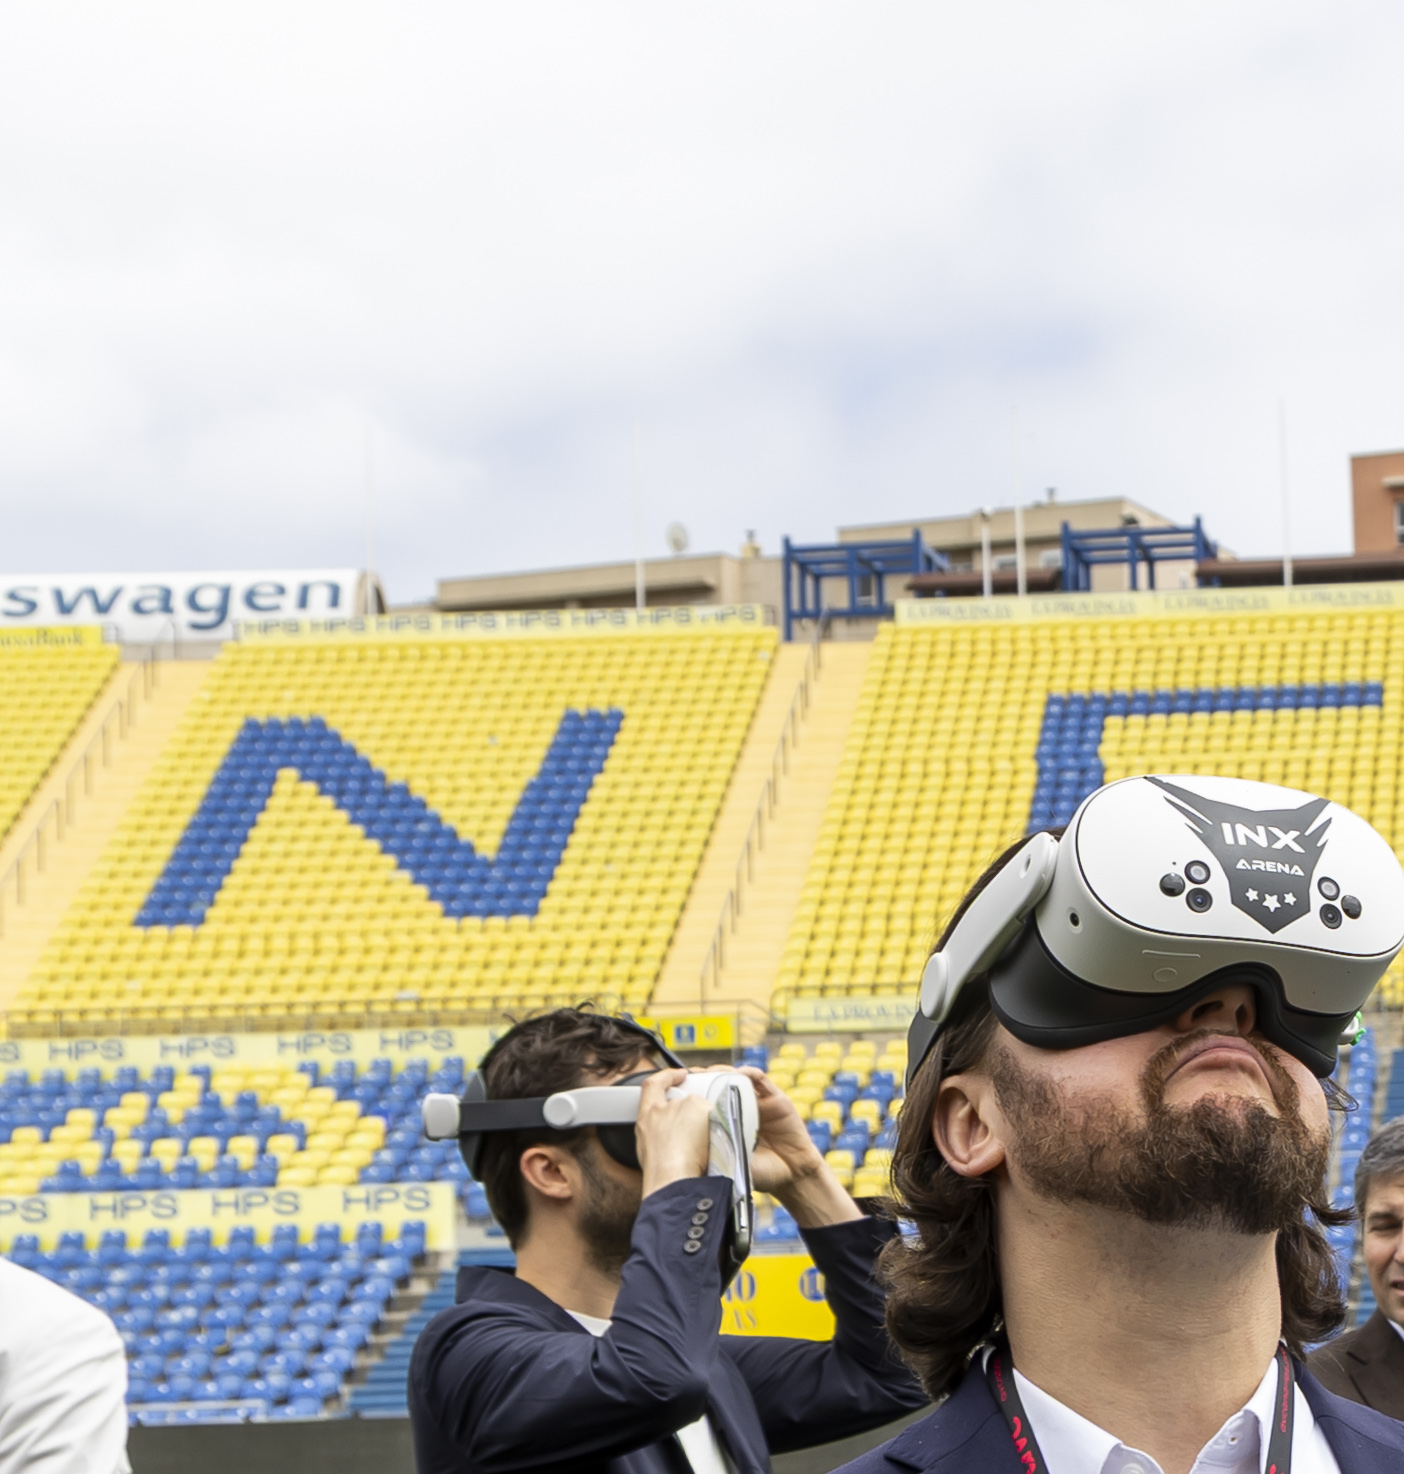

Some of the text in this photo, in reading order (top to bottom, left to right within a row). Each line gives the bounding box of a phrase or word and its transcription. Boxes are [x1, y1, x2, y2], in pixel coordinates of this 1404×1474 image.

[1, 579, 341, 631] swagen
[1221, 822, 1306, 853] INX
[1236, 859, 1305, 876] ARENA
[49, 1039, 125, 1062] HPS
[161, 1036, 237, 1059] HPS
[277, 1032, 353, 1056] HPS
[379, 1029, 455, 1053] HPS
[90, 1194, 179, 1221] HPS
[212, 1190, 303, 1217] HPS
[342, 1187, 433, 1213] HPS
